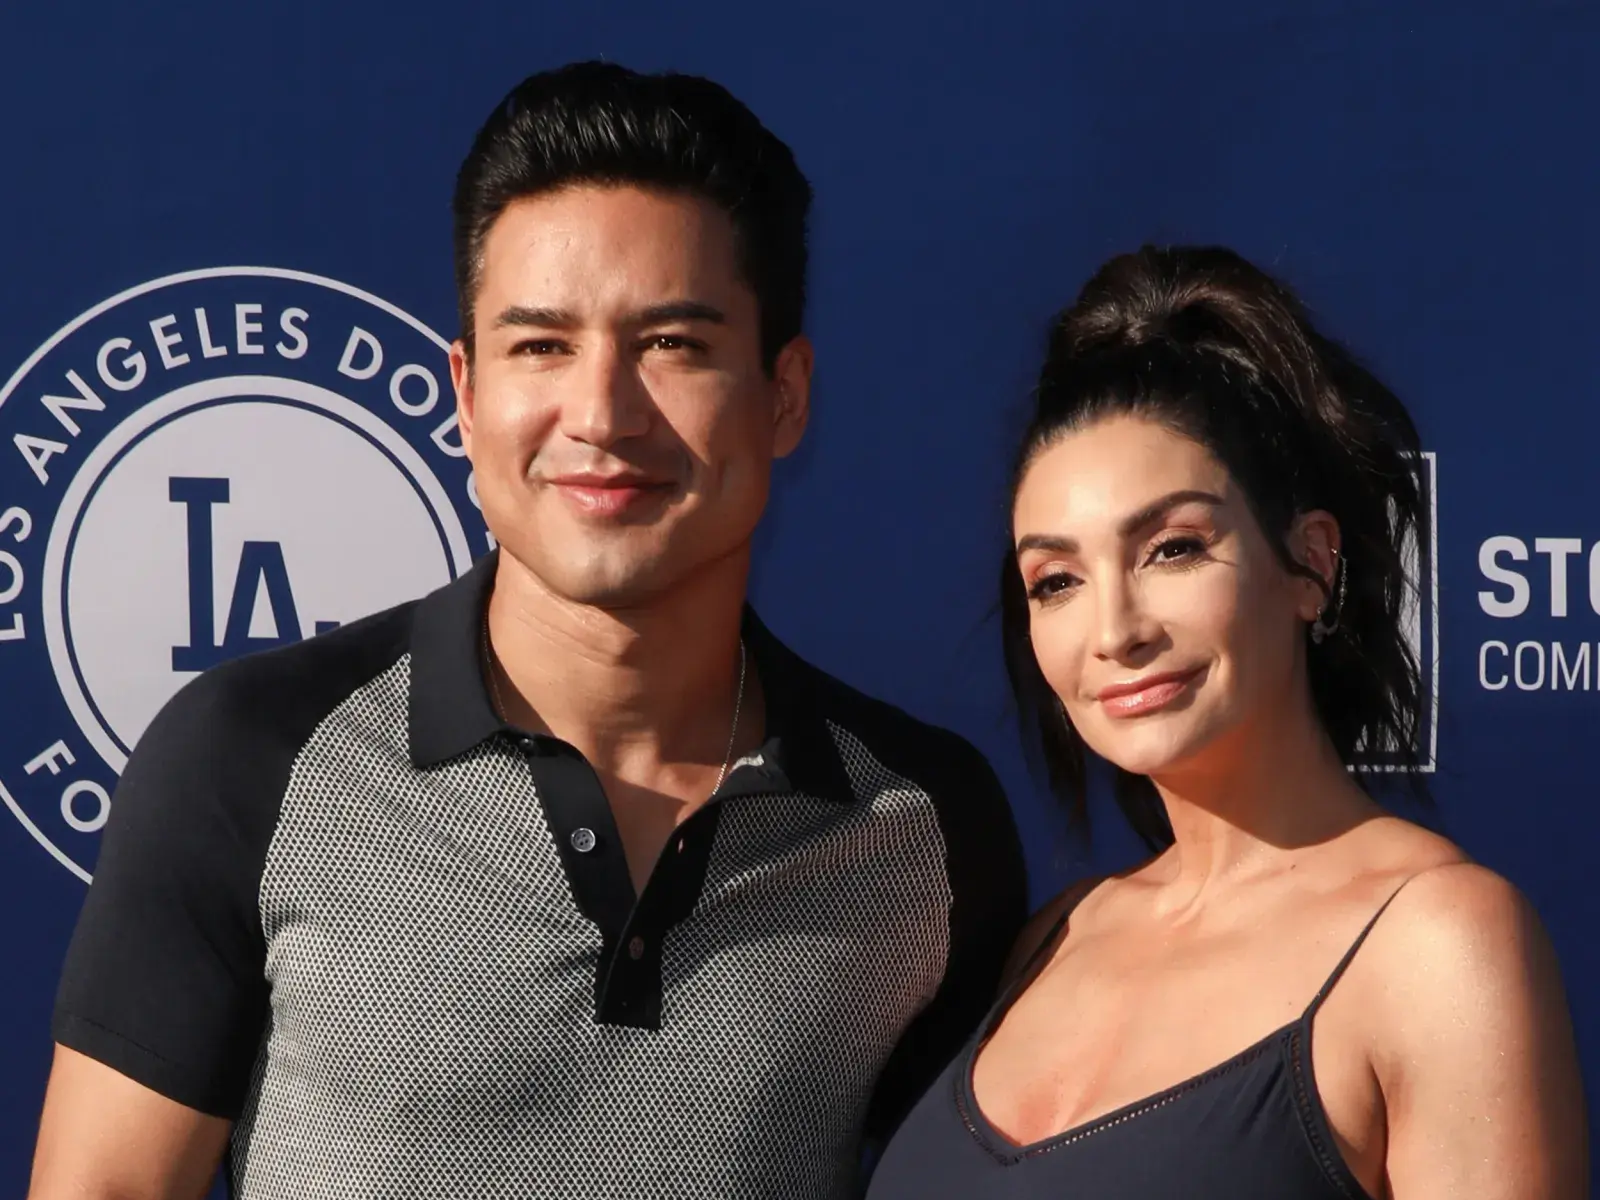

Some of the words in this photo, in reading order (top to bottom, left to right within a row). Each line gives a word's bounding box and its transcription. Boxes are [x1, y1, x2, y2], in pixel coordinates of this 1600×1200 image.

[13, 303, 310, 485] ANGELES
[1477, 535, 1600, 618] ST
[1478, 640, 1600, 691] COM
